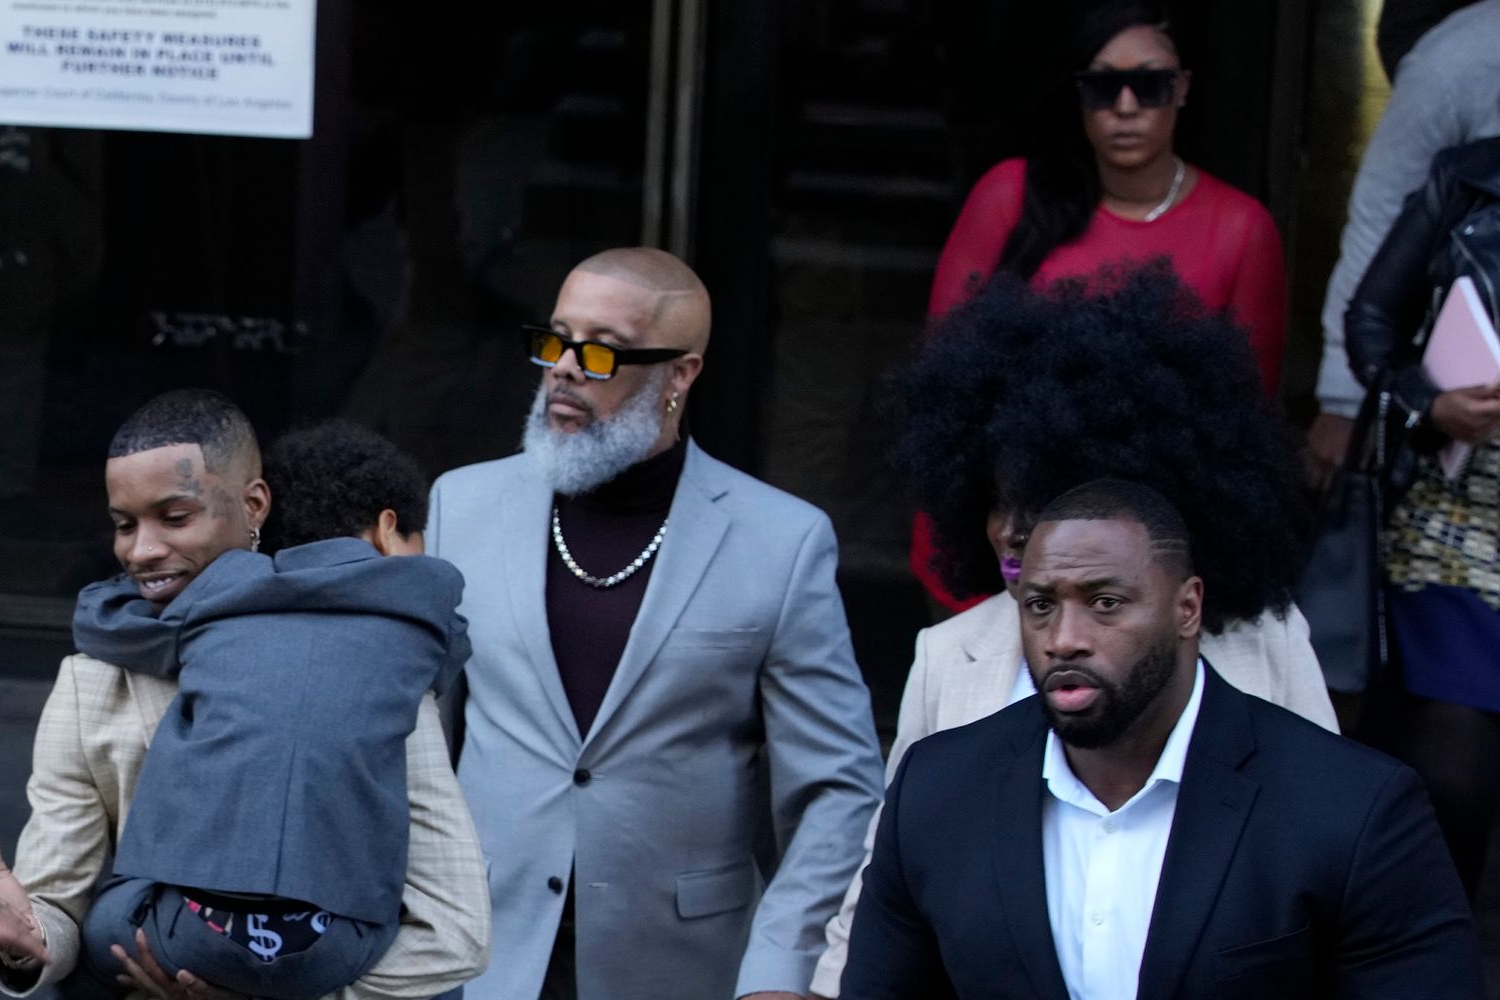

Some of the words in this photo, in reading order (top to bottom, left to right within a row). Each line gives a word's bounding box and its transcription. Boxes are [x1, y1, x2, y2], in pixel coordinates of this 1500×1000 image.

[22, 25, 78, 39] THESE
[87, 28, 155, 42] SAFETY
[163, 33, 262, 48] MEASURES
[7, 42, 48, 56] WILL
[55, 44, 126, 58] REMAIN
[133, 48, 150, 59] IN
[155, 49, 213, 63] PLACE
[219, 53, 275, 67] UNTIL
[61, 60, 146, 75] FURTHER
[152, 65, 218, 80] NOTICE
